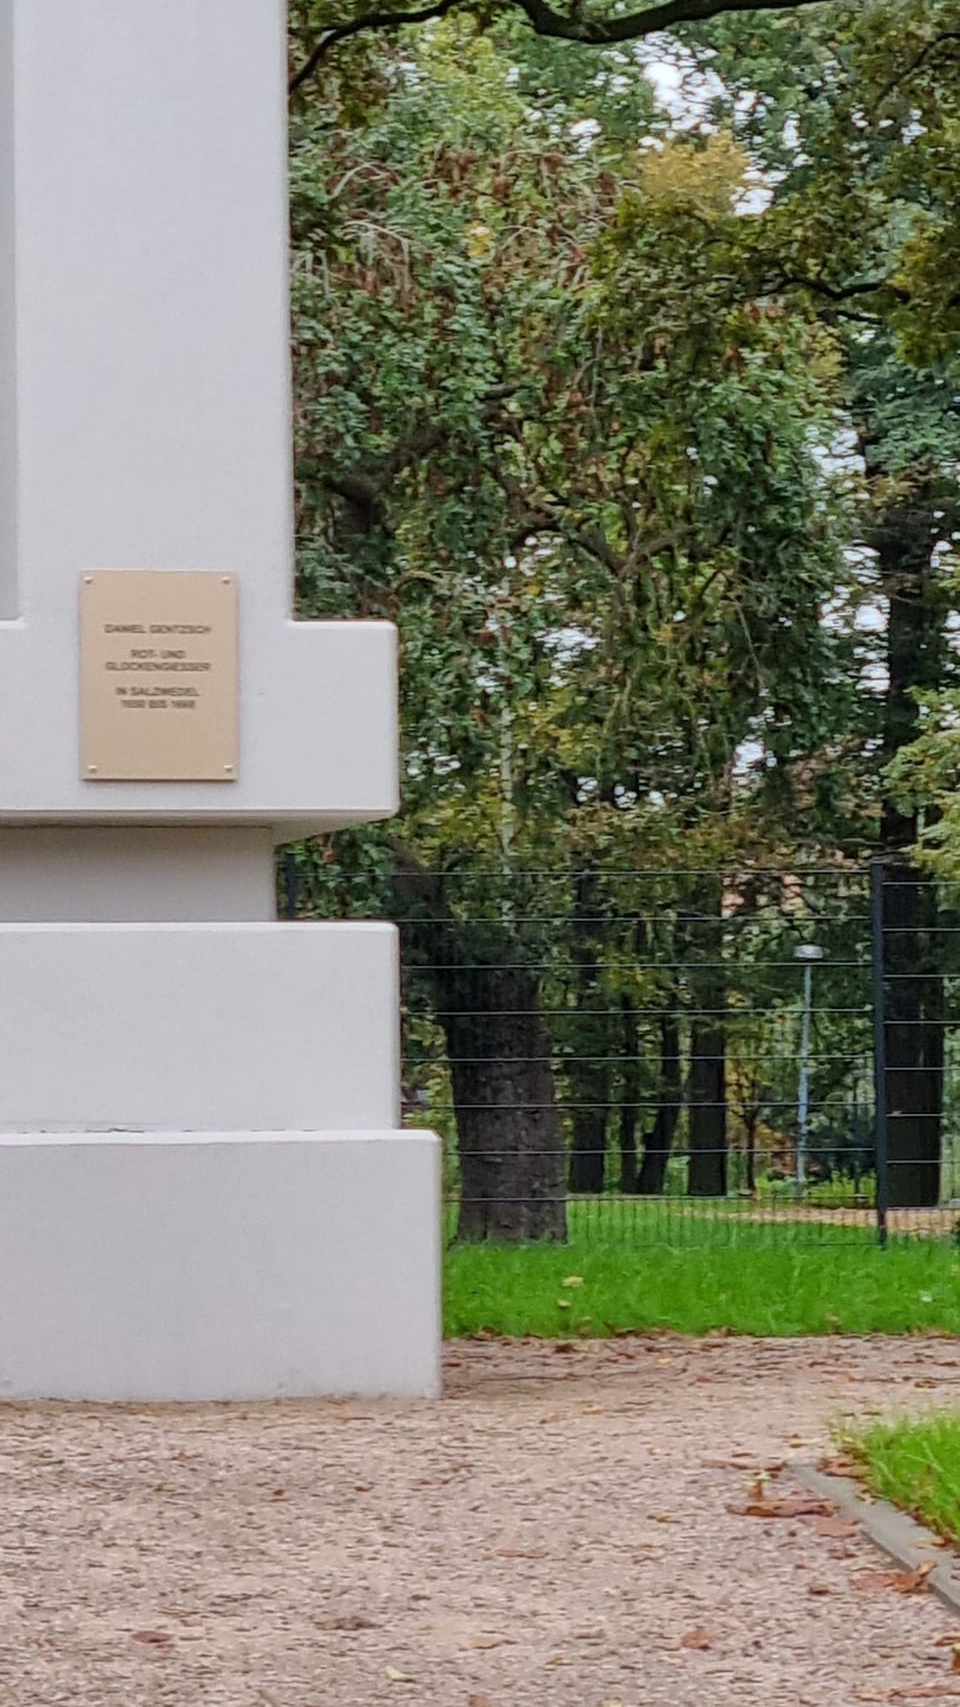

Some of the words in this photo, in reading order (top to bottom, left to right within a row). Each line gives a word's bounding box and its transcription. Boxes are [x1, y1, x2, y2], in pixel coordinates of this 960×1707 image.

[104, 624, 147, 634] DANIEL
[160, 649, 186, 659] UND
[105, 661, 212, 672] GLOCKENGIESSER
[115, 687, 127, 696] IN
[130, 687, 200, 697] SALZWEDEL
